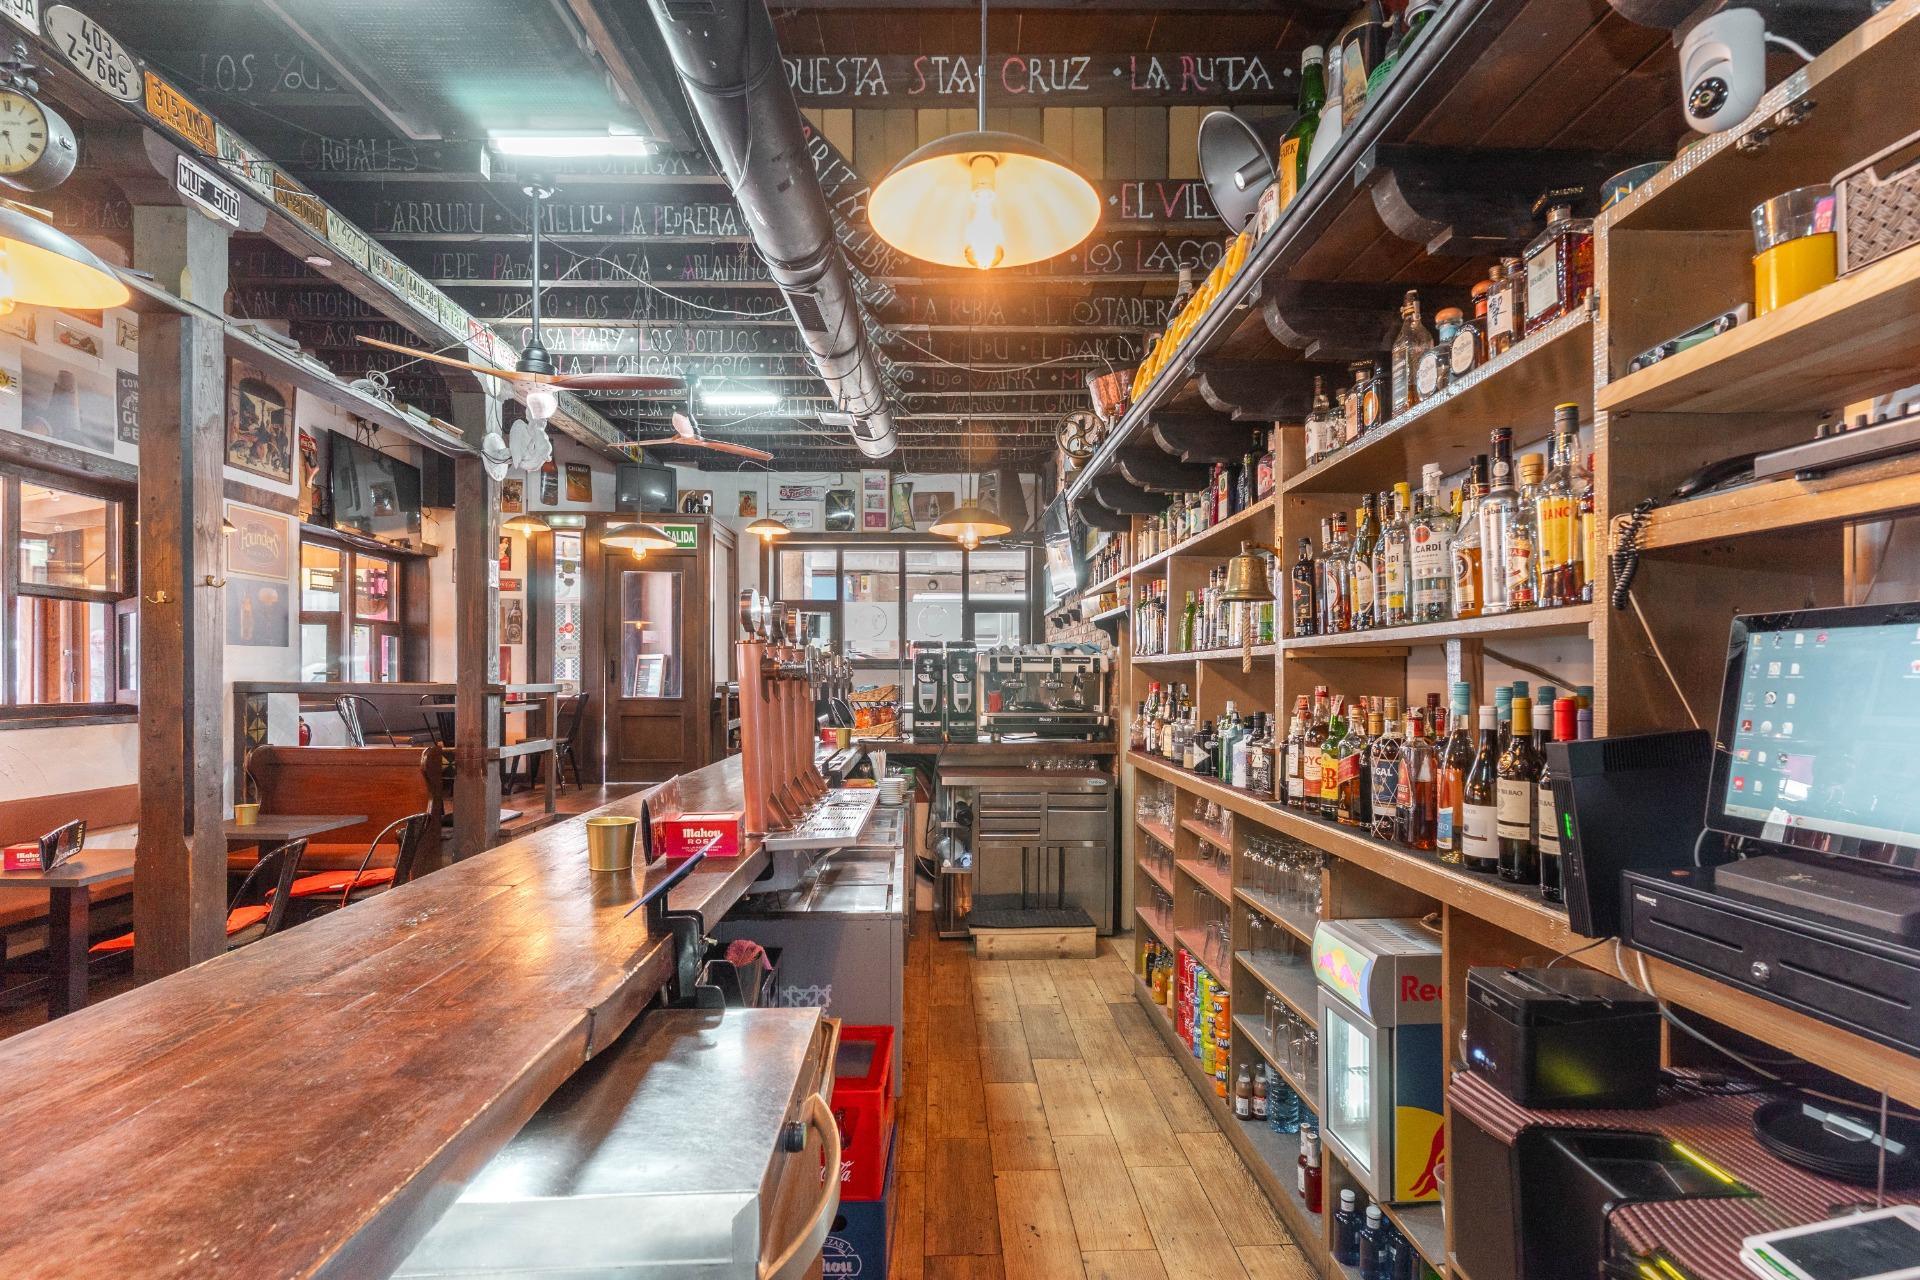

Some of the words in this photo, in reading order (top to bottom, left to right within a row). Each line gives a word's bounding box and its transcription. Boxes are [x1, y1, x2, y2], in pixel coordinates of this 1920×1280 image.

[82, 20, 113, 61] 403
[67, 33, 128, 95] Z-7685
[1001, 56, 1091, 93] CRUZ
[1129, 55, 1171, 91] LA
[1180, 55, 1275, 92] RUTA
[180, 164, 207, 193] MUF
[213, 188, 239, 219] 500
[1120, 182, 1154, 219] EL
[1155, 182, 1221, 219] VIE
[619, 204, 646, 234] LA
[653, 203, 738, 236] PEDRERA
[431, 252, 479, 280] PEPE
[1084, 239, 1124, 274] LOS
[573, 293, 609, 319] LOS
[911, 296, 939, 325] LA
[1069, 296, 1179, 326] TOSTADER
[571, 328, 624, 351] MARY
[639, 328, 672, 352] LOS
[685, 328, 761, 353] BOTIJOS
[241, 527, 280, 558] Founders
[666, 529, 695, 545] SALIDA
[683, 828, 722, 840] Mahou
